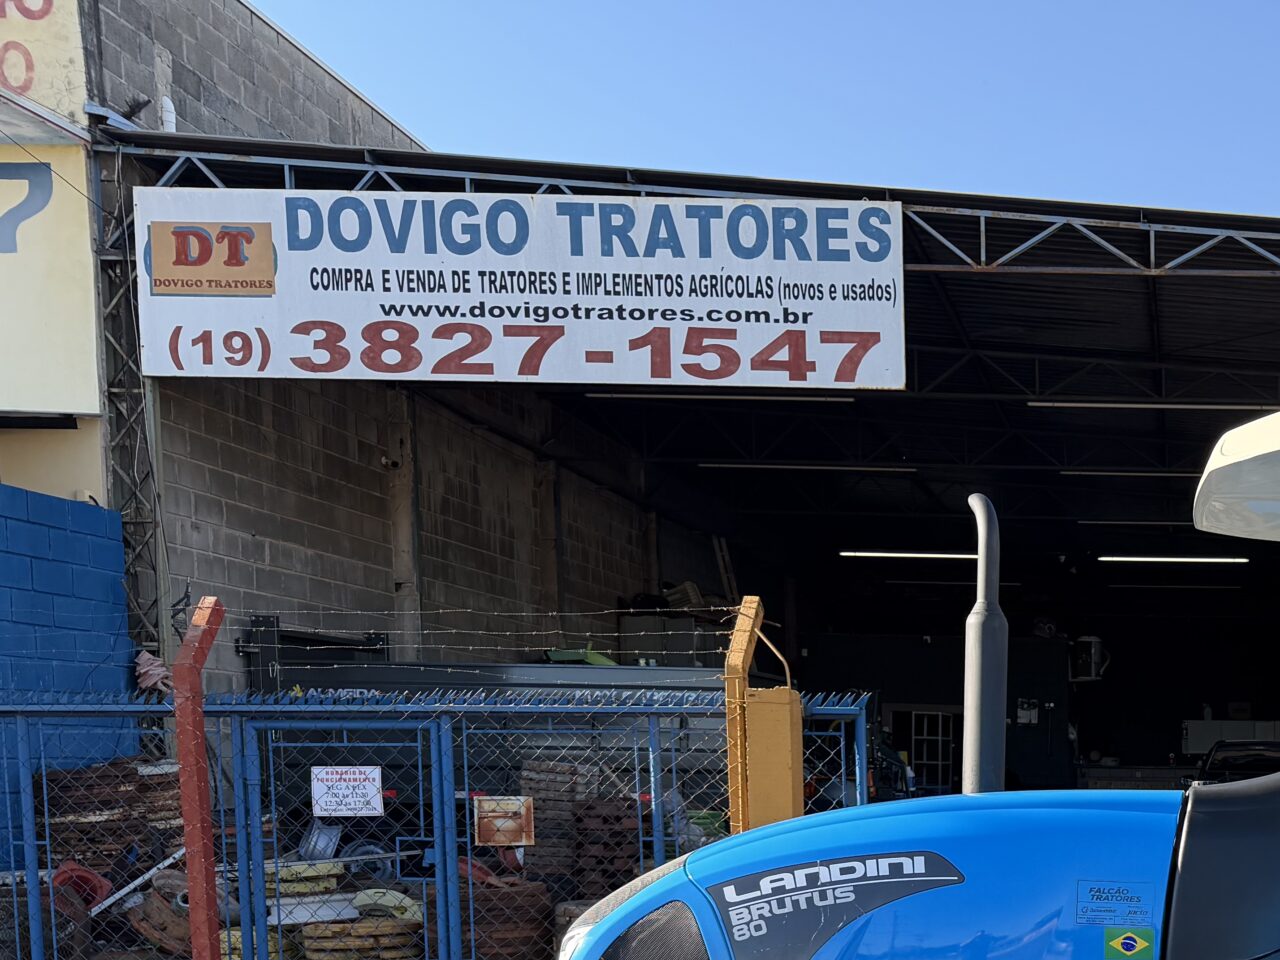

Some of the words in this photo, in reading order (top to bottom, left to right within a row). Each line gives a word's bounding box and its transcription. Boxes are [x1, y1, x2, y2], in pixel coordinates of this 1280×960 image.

[170, 224, 256, 268] DT
[284, 196, 530, 256] DOVIGO
[555, 201, 892, 263] TRATORES
[153, 278, 204, 288] DOVIGO
[206, 279, 273, 289] TRATORES
[309, 266, 375, 293] COMPRA
[382, 269, 392, 293] E
[395, 269, 448, 294] VENDA
[451, 269, 471, 294] DE
[477, 270, 557, 296] TRATORES
[562, 272, 572, 296] E
[576, 272, 684, 298] IMPLEMENTOS
[688, 266, 774, 299] AGRÍCOLAS
[778, 276, 824, 306] (novos
[828, 283, 838, 301] e
[841, 277, 897, 309] usados)
[378, 301, 814, 324] www.dovigotratores.com.br
[168, 325, 272, 372] (19)
[289, 319, 881, 383] 3827-1547
[722, 855, 926, 904] LANDINI
[1088, 886, 1130, 896] FALCÃO
[1090, 893, 1142, 903] TRATORES
[728, 885, 856, 927] BRUTUS
[732, 919, 768, 942] 80
